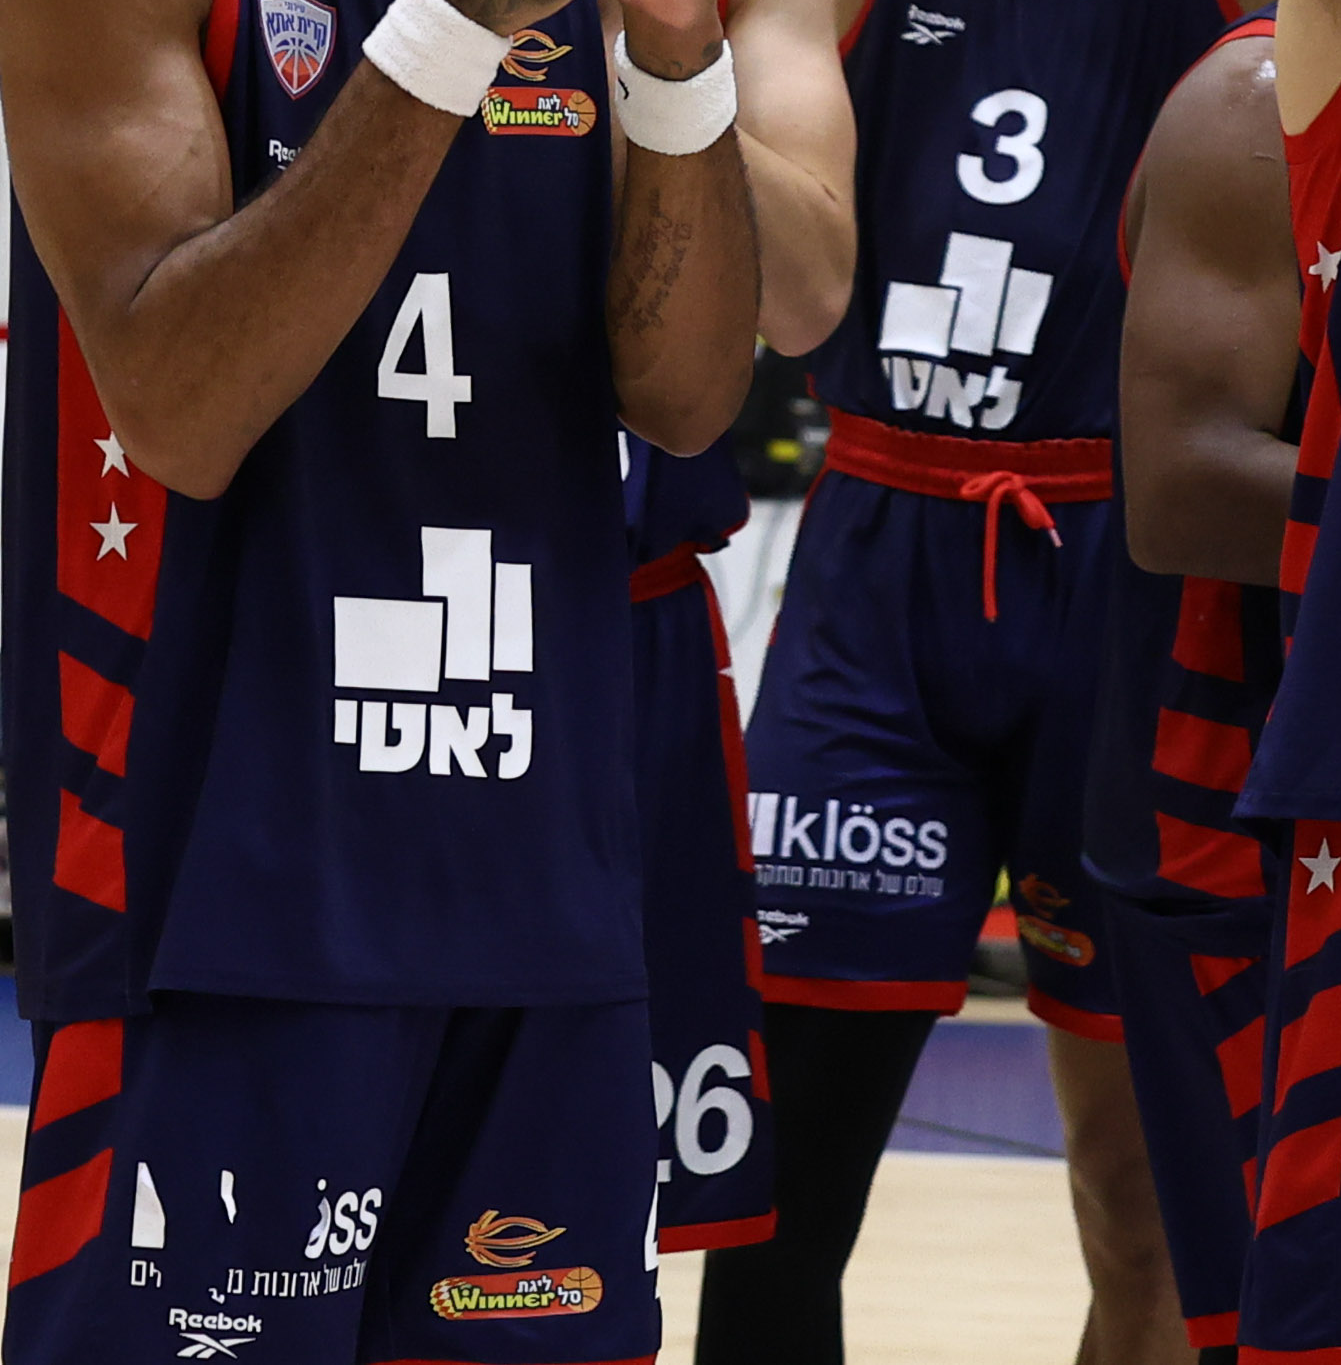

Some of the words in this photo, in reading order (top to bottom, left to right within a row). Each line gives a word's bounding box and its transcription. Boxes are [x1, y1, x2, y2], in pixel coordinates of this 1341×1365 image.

[266, 11, 295, 43] אתא
[296, 15, 328, 51] קרית
[489, 99, 564, 125] Winner
[537, 94, 561, 111] ליגת
[564, 107, 579, 126] סל
[955, 88, 1049, 205] 3
[377, 272, 473, 439] 4
[880, 355, 1024, 430] לאטי
[334, 692, 534, 780] לאטי
[780, 795, 949, 870] klöss
[251, 1270, 321, 1297] ארונות
[517, 1275, 552, 1293] ליגת
[557, 1286, 582, 1305] סל
[450, 1287, 556, 1310] Winner
[169, 1308, 263, 1333] Reebok
